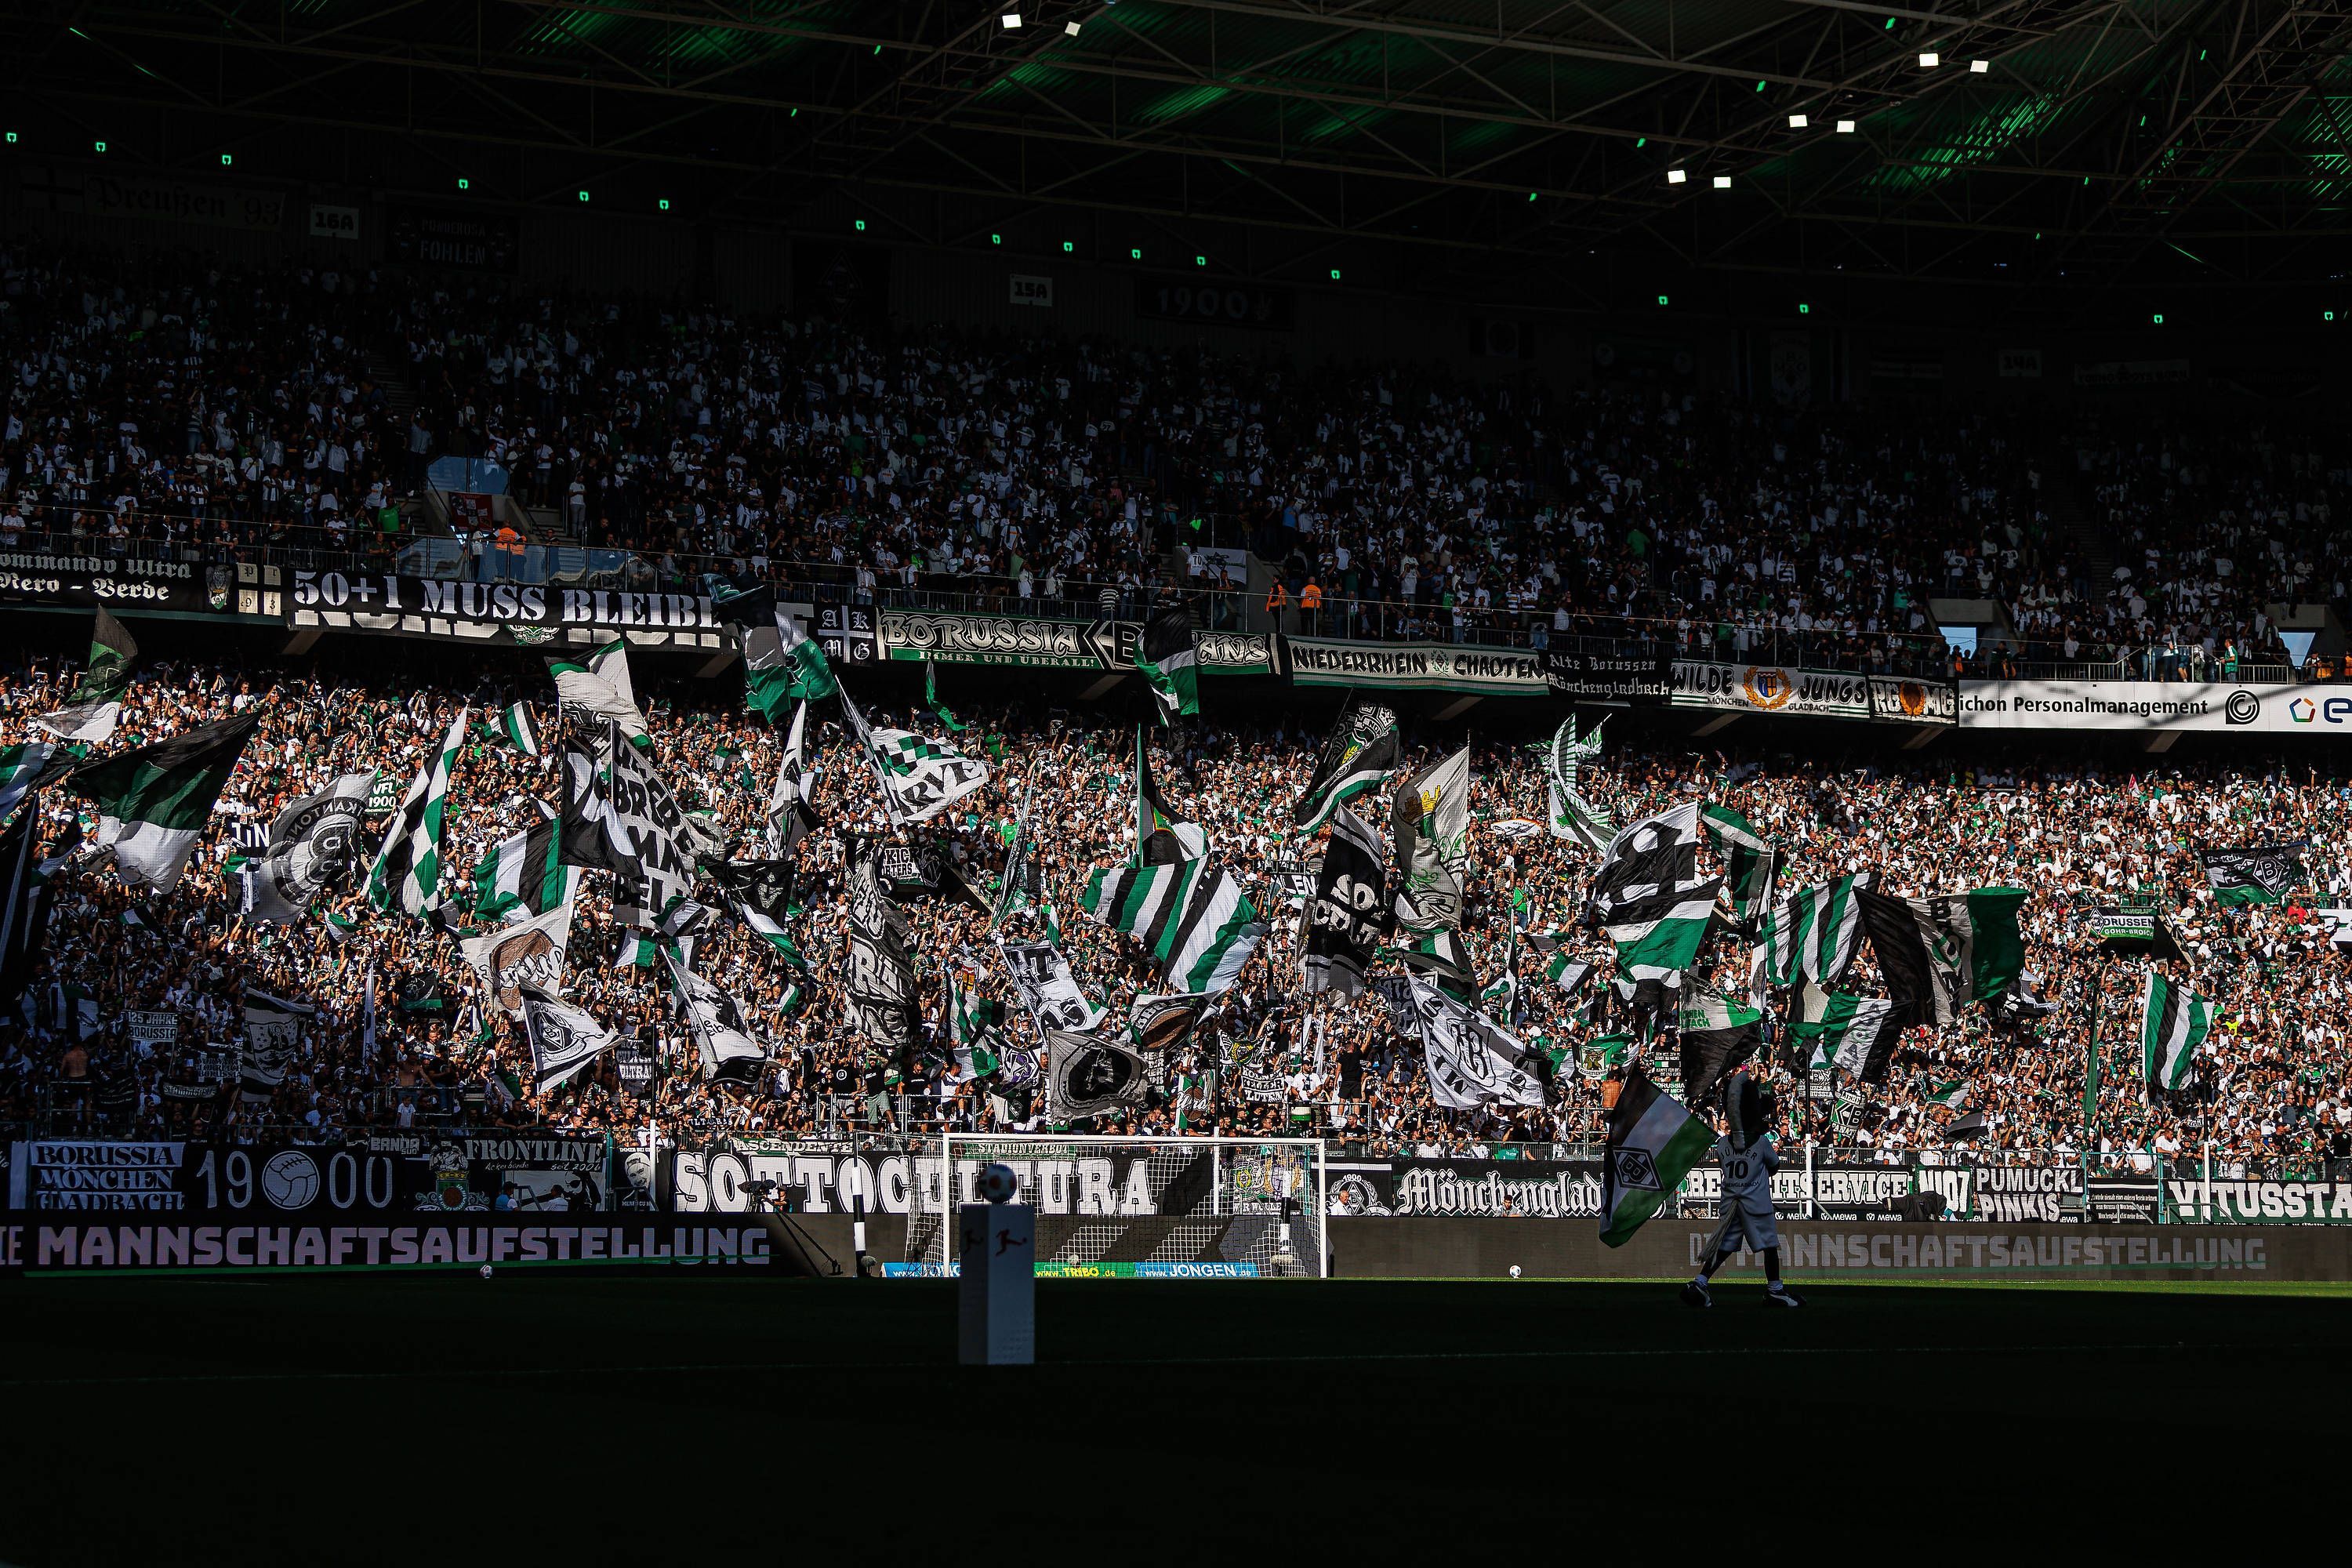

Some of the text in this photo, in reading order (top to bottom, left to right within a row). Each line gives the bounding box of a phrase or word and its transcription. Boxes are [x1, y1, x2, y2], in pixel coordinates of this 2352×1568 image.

[316, 212, 354, 230] 16A
[1015, 281, 1047, 299] 15A
[1158, 287, 1248, 318] 1900
[2004, 355, 2037, 370] 14A
[125, 559, 191, 579] Ultra
[92, 579, 169, 602] Verde
[295, 570, 404, 610] 50+1
[422, 580, 548, 622] MUSS
[883, 614, 1083, 655] BORUSSIA
[920, 649, 1095, 671] IMMER UND ÜBERALL!
[1292, 645, 1547, 679] NIEDERRHEIN CHAOTEN
[1549, 654, 1581, 670] Alte
[1671, 663, 1867, 706] WILDE JUNGS
[1707, 695, 1829, 713] MÖNCHEN GLADBACH
[1959, 695, 2209, 717] ichon Personalmanagement
[368, 797, 396, 808] 1900
[147, 1013, 178, 1026] JAHRE
[129, 1025, 177, 1041] BORUSSIA
[372, 1137, 420, 1152] BANDA
[466, 1139, 603, 1165] FRONTLINE
[739, 1138, 855, 1155] ASCENDENTE
[38, 1146, 177, 1166] BORUSSIA
[38, 1165, 175, 1190] MÖNCHEN
[196, 1149, 252, 1209] 19
[330, 1152, 394, 1209] 00
[1725, 1160, 1748, 1180] 10
[1976, 1167, 2084, 1192] PUMUCKL
[1396, 1167, 1606, 1217] Mönchenglad
[39, 1225, 771, 1266] MANNSCHAFTSAUFSTELLUNG
[1168, 1262, 1236, 1276] JONGEN
